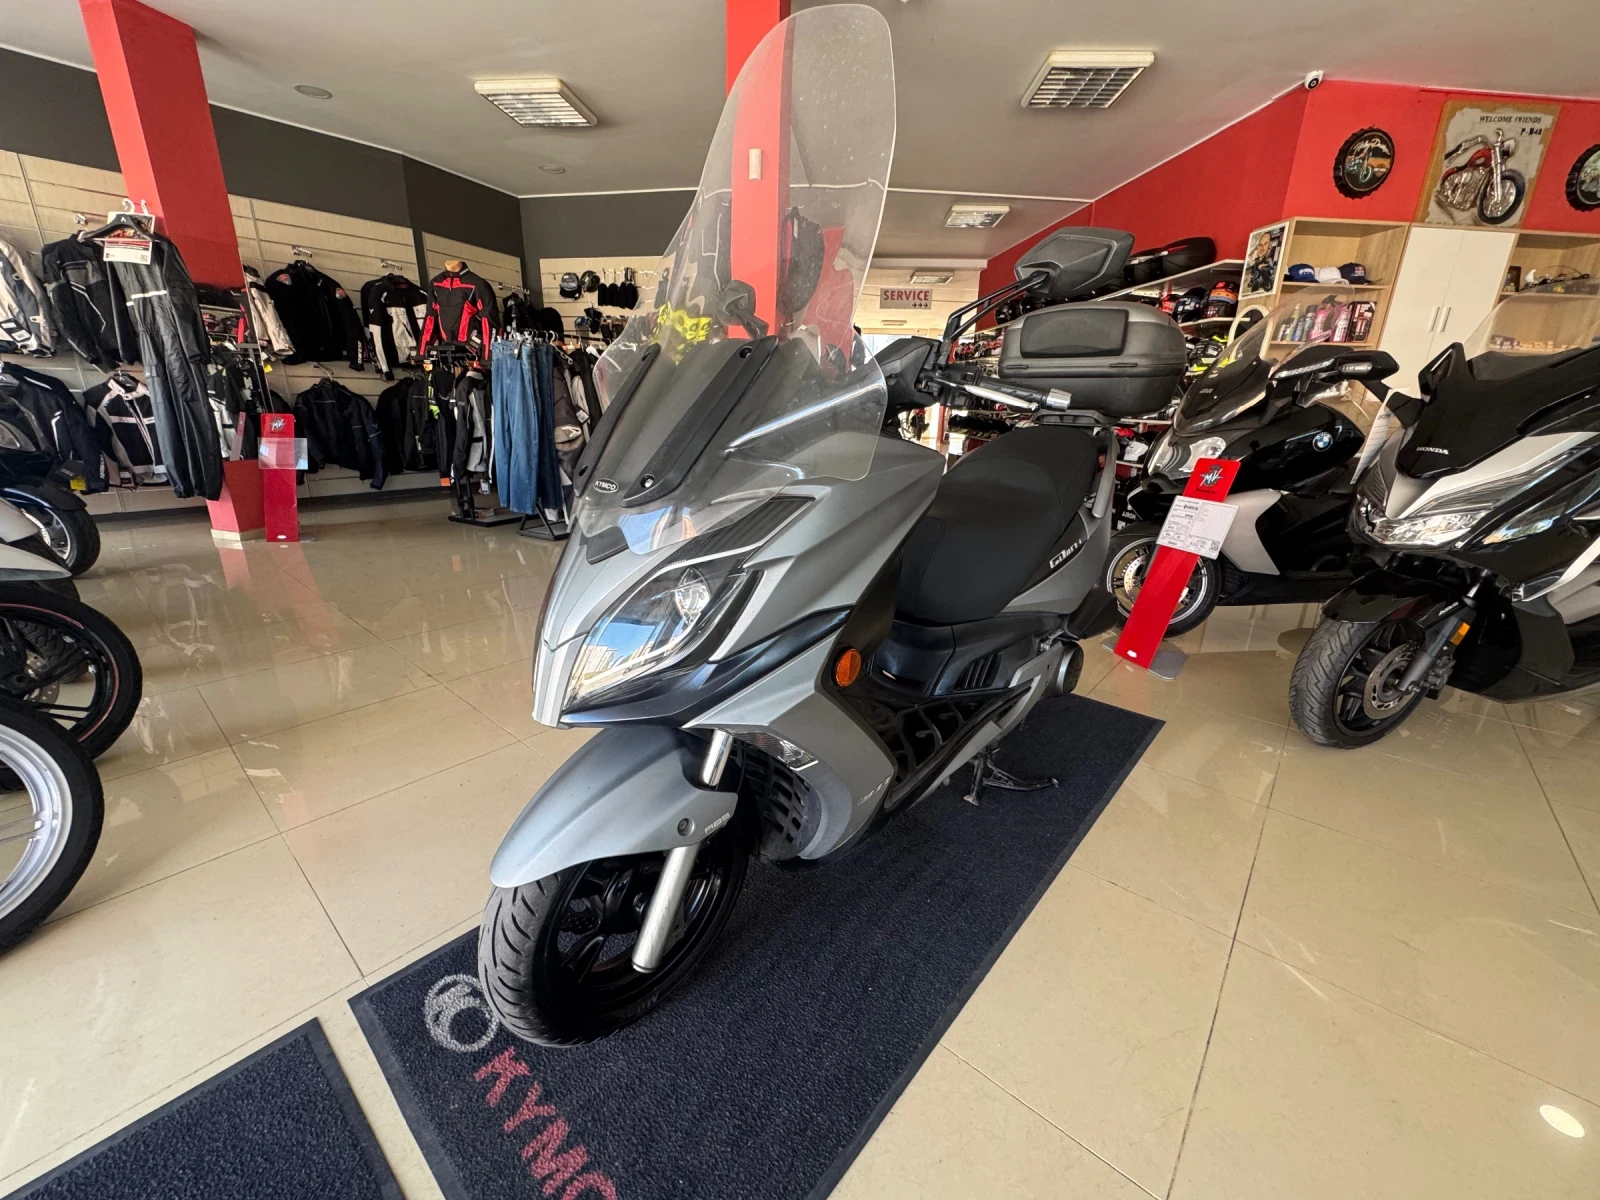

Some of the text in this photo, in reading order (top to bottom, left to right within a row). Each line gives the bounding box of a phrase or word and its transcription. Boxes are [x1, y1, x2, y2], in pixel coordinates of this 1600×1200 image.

[1514, 116, 1542, 124] FRIENDS
[883, 290, 930, 301] SERVICE
[1415, 446, 1449, 455] HONDA
[594, 480, 617, 491] KYMCO
[704, 811, 731, 834] ABS
